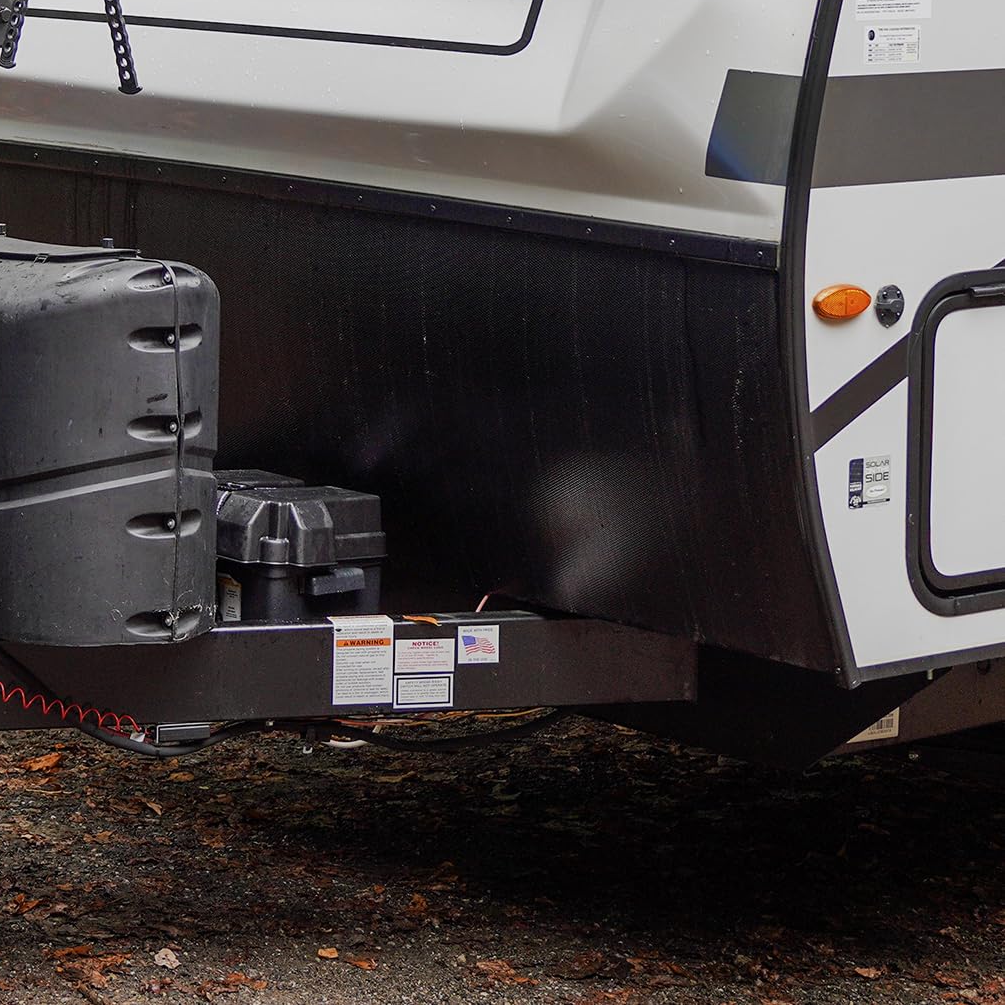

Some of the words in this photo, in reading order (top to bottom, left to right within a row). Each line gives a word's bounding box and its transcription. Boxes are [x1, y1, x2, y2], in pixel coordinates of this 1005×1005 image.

[865, 459, 890, 469] SOLAR
[865, 472, 890, 483] SIDE
[349, 639, 384, 647] WARNING
